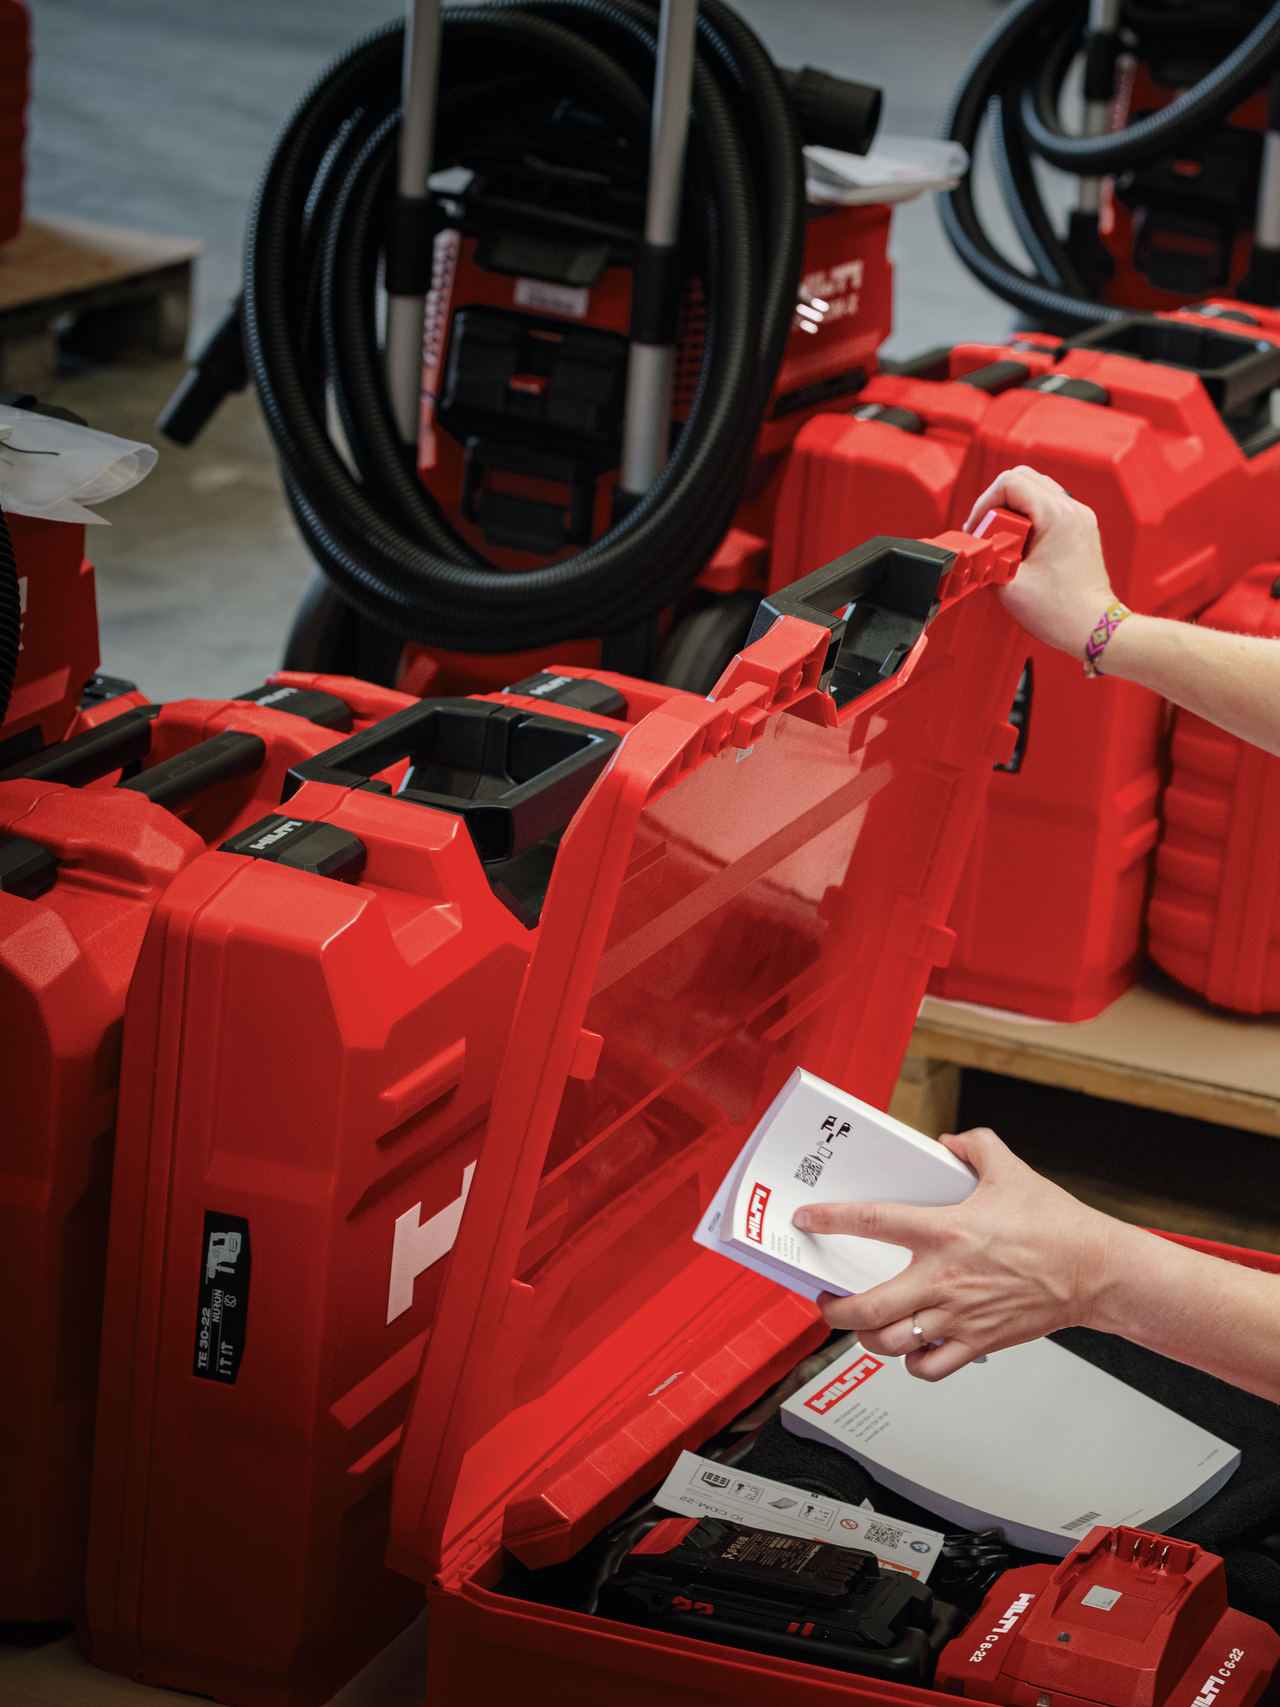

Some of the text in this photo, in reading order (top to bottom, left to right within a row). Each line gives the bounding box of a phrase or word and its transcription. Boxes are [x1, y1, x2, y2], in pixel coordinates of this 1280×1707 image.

[249, 820, 303, 850] HILTI
[748, 1187, 769, 1242] HILTI
[212, 1289, 223, 1323] NURON
[198, 1307, 211, 1369] TE 30-22
[810, 1357, 878, 1411] HILTI
[680, 1495, 744, 1522] IC CDM-22
[969, 1592, 1036, 1663] HILTI C 6-22
[1218, 1668, 1231, 1677] C
[1223, 1648, 1245, 1669] 6-22
